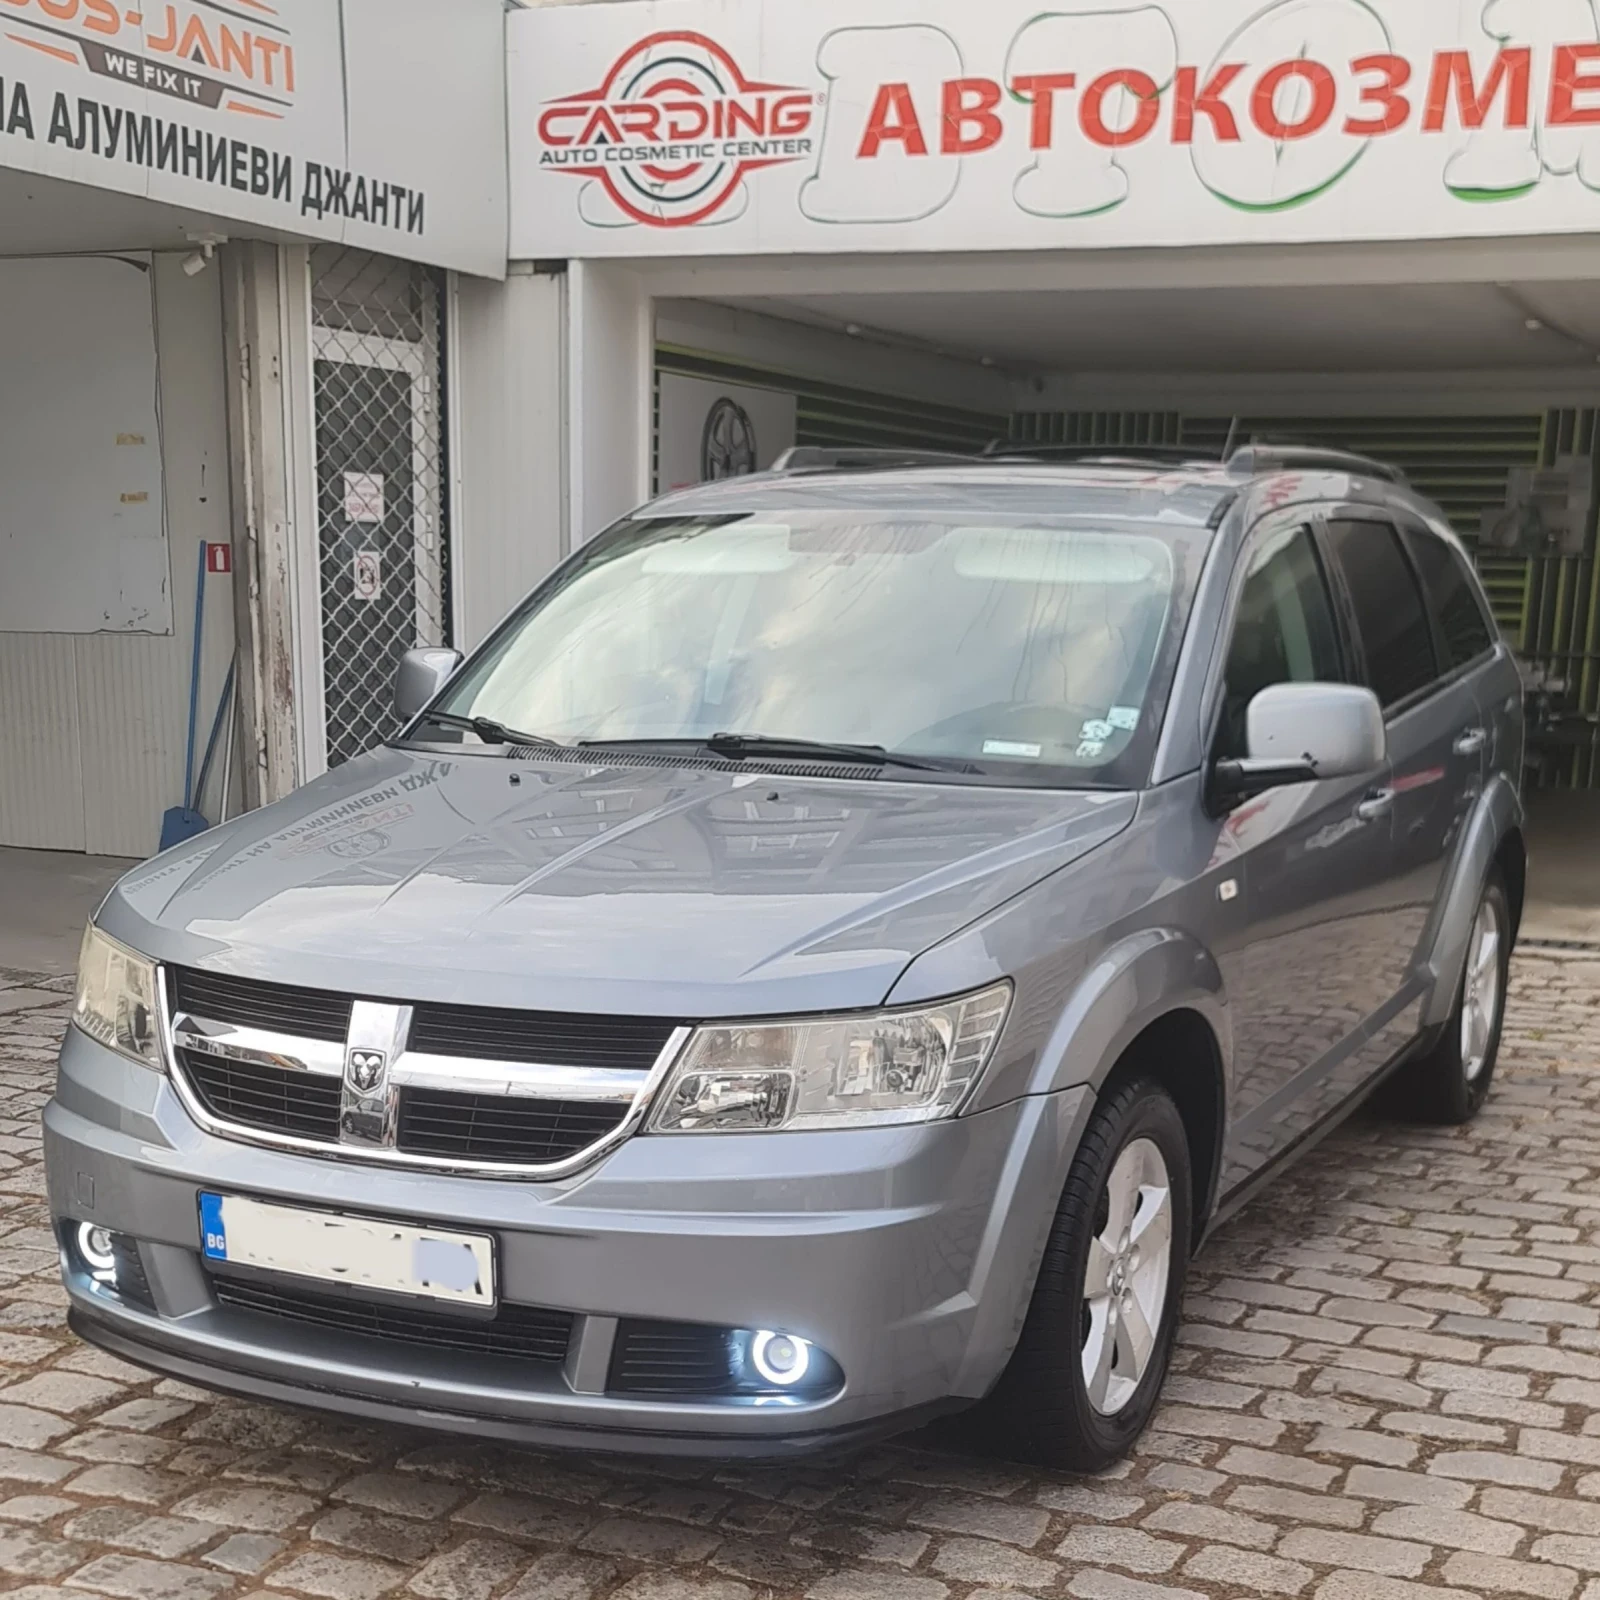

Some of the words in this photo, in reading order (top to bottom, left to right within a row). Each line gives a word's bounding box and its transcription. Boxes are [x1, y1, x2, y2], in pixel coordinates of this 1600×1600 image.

[0, 0, 294, 92] S-JANTI
[104, 52, 138, 79] WE
[143, 65, 178, 92] FIX
[183, 77, 202, 98] IT
[855, 44, 1600, 158] АВТОКОЗМЕ
[538, 94, 813, 146] CARDING
[0, 76, 35, 140] А
[47, 91, 291, 203] АЛУМИНИЕВИ
[301, 161, 424, 235] ДЖАНТИ
[539, 149, 597, 164] AUTO
[605, 144, 715, 161] COSMETIC
[723, 138, 812, 157] CENTER
[207, 1232, 225, 1250] BG
